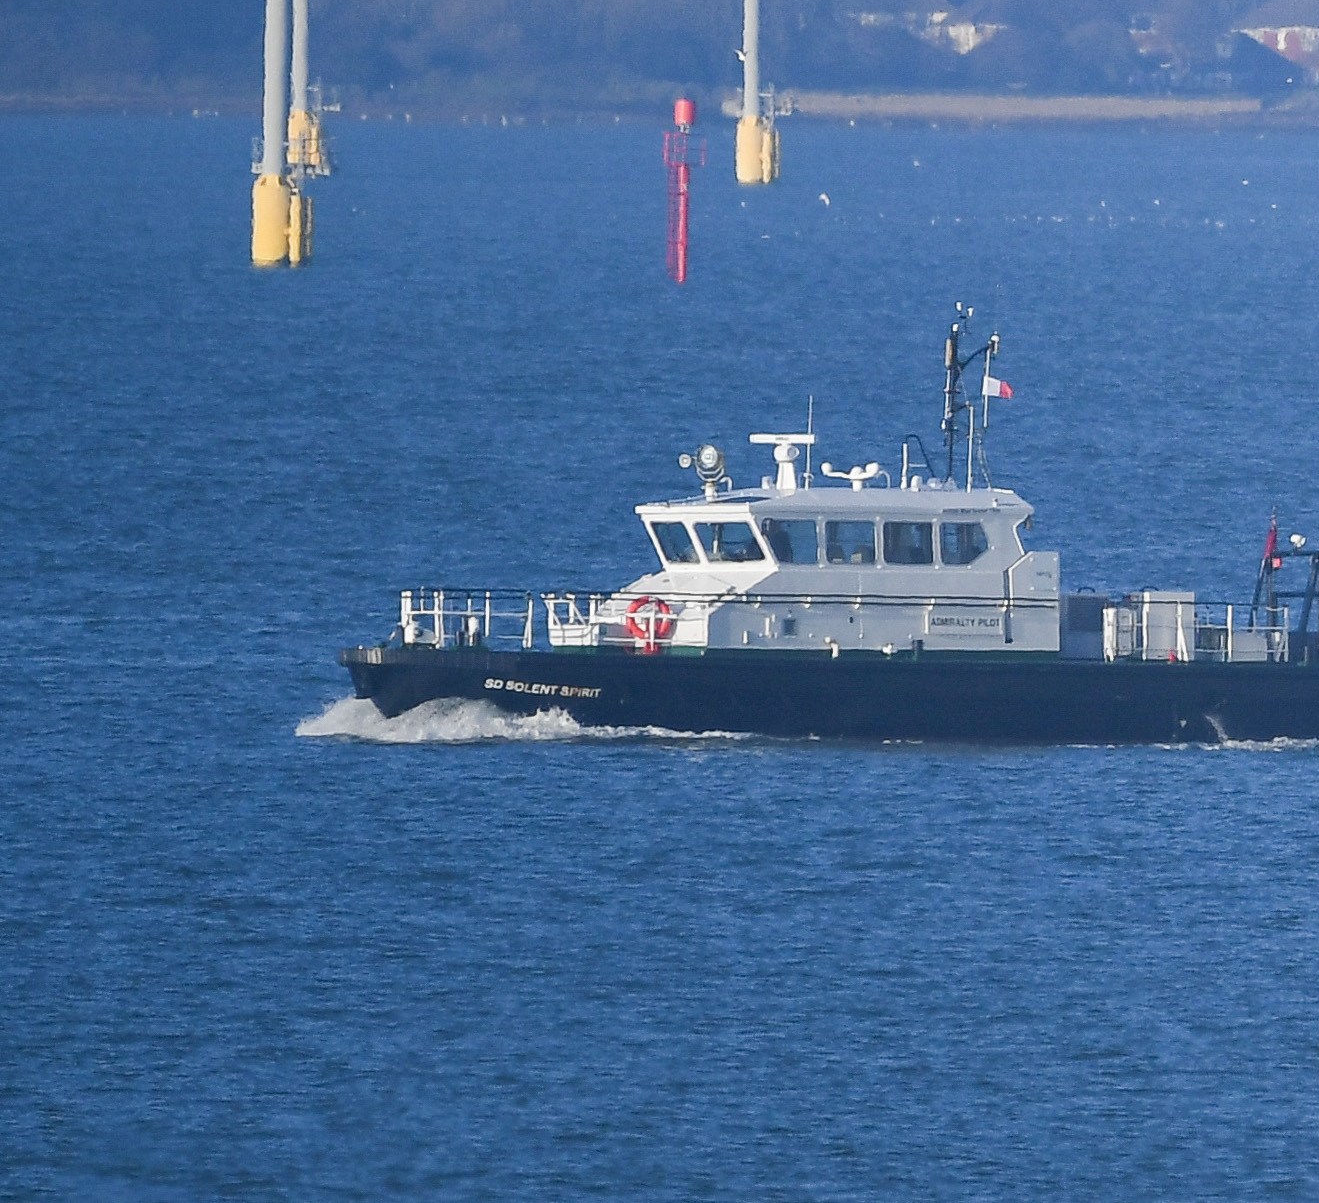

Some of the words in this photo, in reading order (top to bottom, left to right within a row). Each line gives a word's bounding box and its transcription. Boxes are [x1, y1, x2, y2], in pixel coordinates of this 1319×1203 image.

[484, 678, 504, 690] SD
[505, 680, 558, 695] SOLENT
[559, 685, 602, 698] SPIRIT
